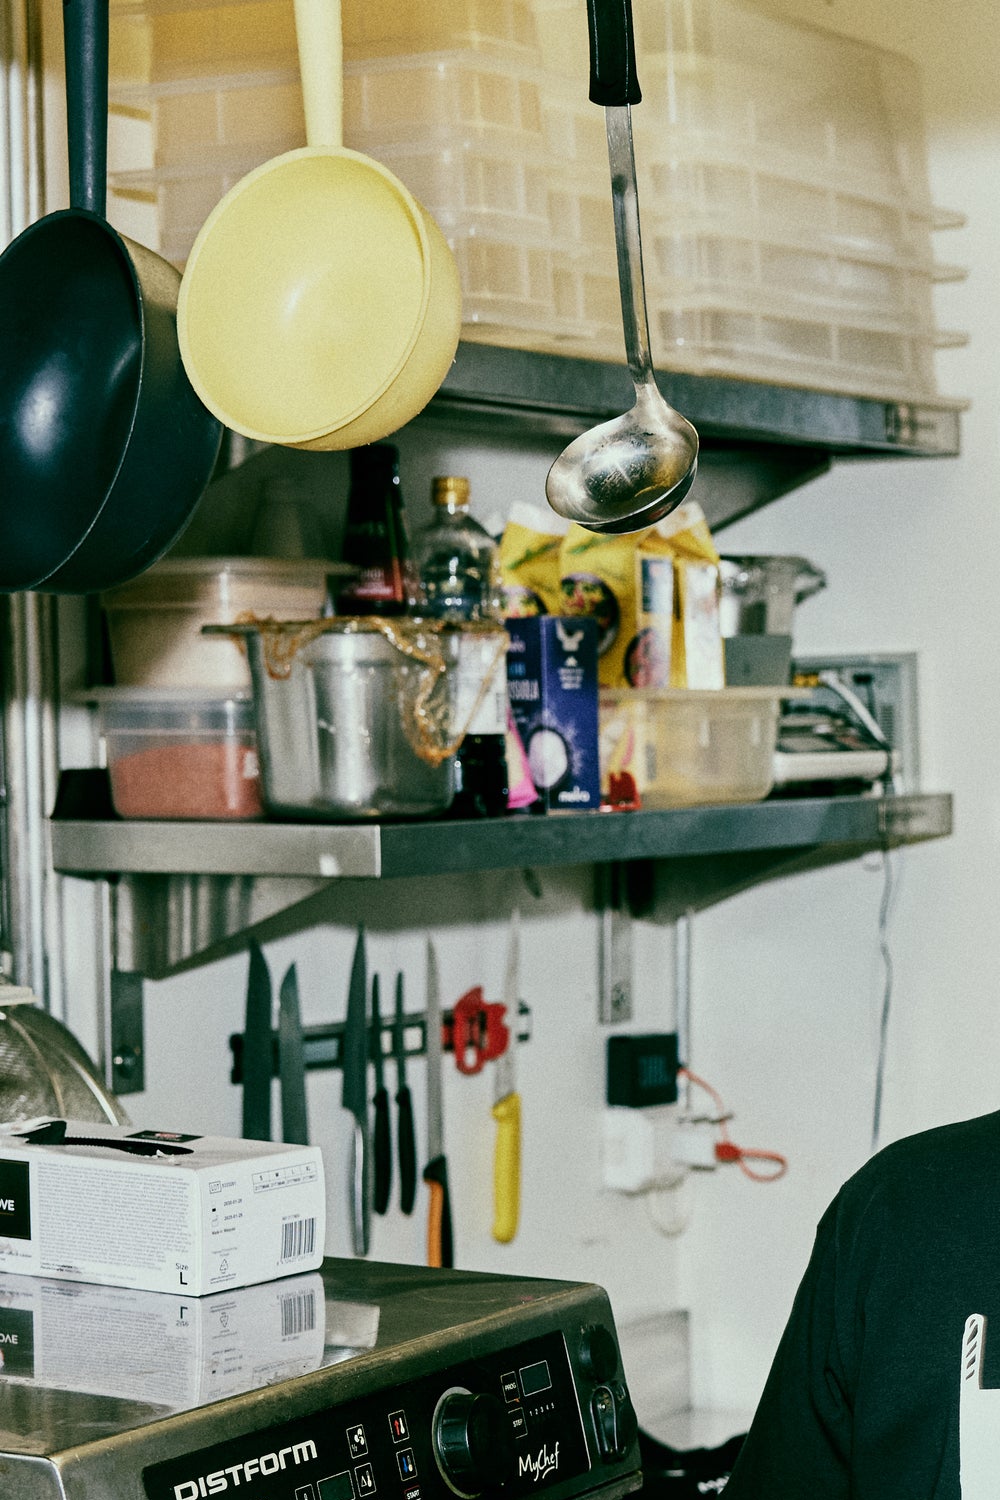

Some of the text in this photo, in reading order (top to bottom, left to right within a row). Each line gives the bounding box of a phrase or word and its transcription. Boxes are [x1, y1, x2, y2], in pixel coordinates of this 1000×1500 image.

[175, 1262, 189, 1271] Size
[179, 1271, 188, 1286] L
[504, 1382, 517, 1391] PROG
[512, 1418, 523, 1428] STEP
[519, 1441, 560, 1482] MyChef
[406, 1489, 420, 1500] START
